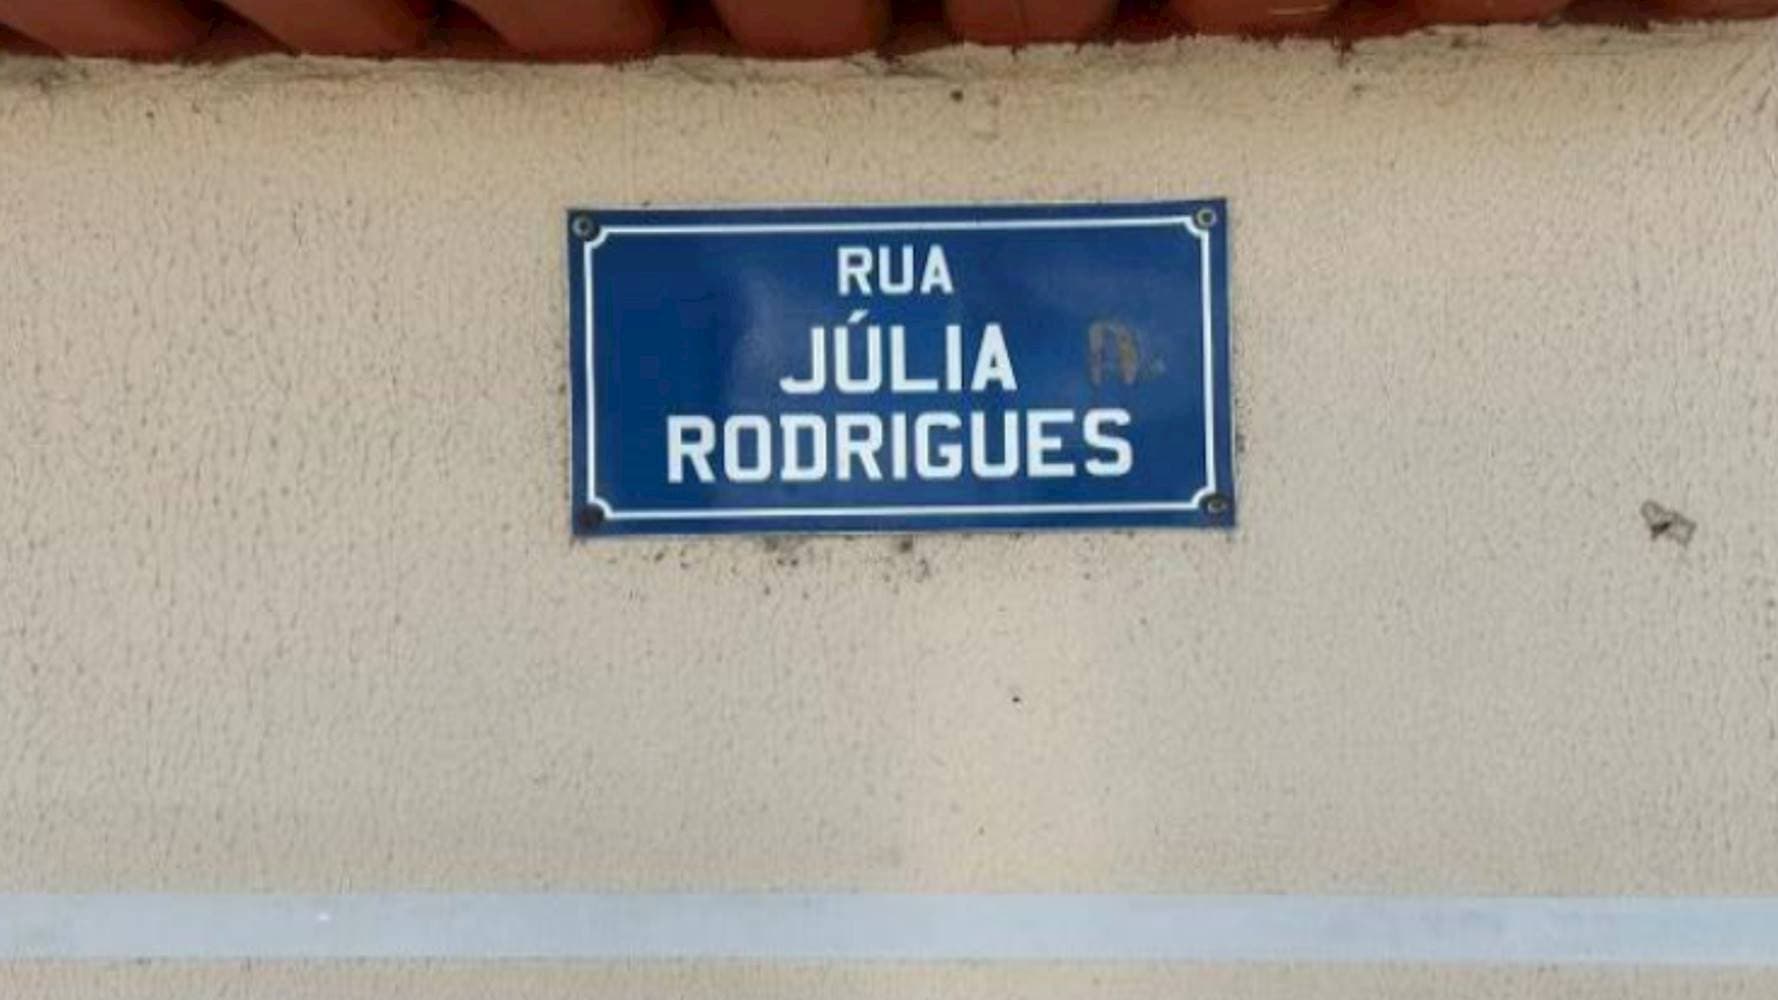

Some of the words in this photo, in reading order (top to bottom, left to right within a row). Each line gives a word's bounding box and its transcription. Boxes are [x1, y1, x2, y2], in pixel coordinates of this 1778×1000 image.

[837, 245, 954, 296] RUA
[779, 310, 1017, 395] JÚLIA
[667, 408, 1133, 484] RODRIGUES
